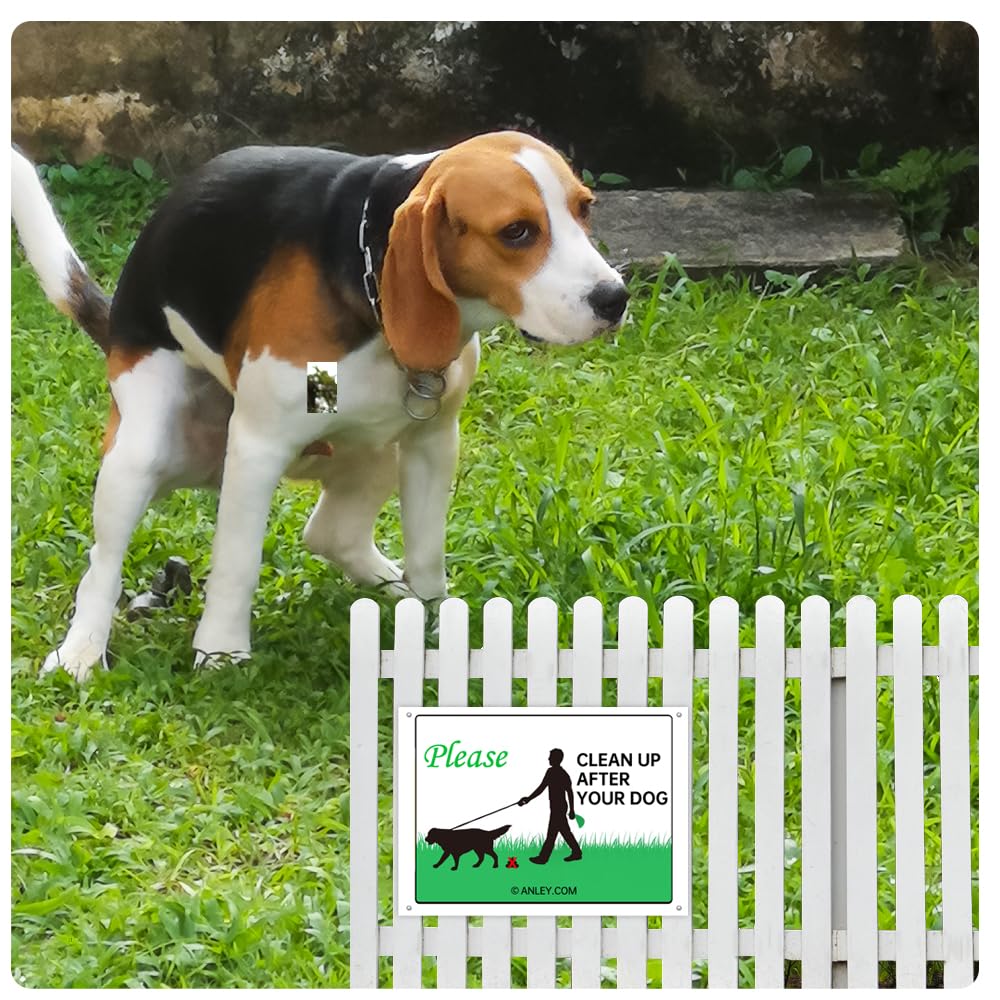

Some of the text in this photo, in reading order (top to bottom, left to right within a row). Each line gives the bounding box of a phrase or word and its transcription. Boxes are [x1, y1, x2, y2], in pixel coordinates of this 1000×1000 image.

[424, 740, 508, 768] Please
[577, 753, 660, 767] CLEAN UP
[577, 772, 630, 786] AFTER
[577, 791, 668, 805] YOUR DOG
[521, 886, 577, 895] ANLEY.COM
